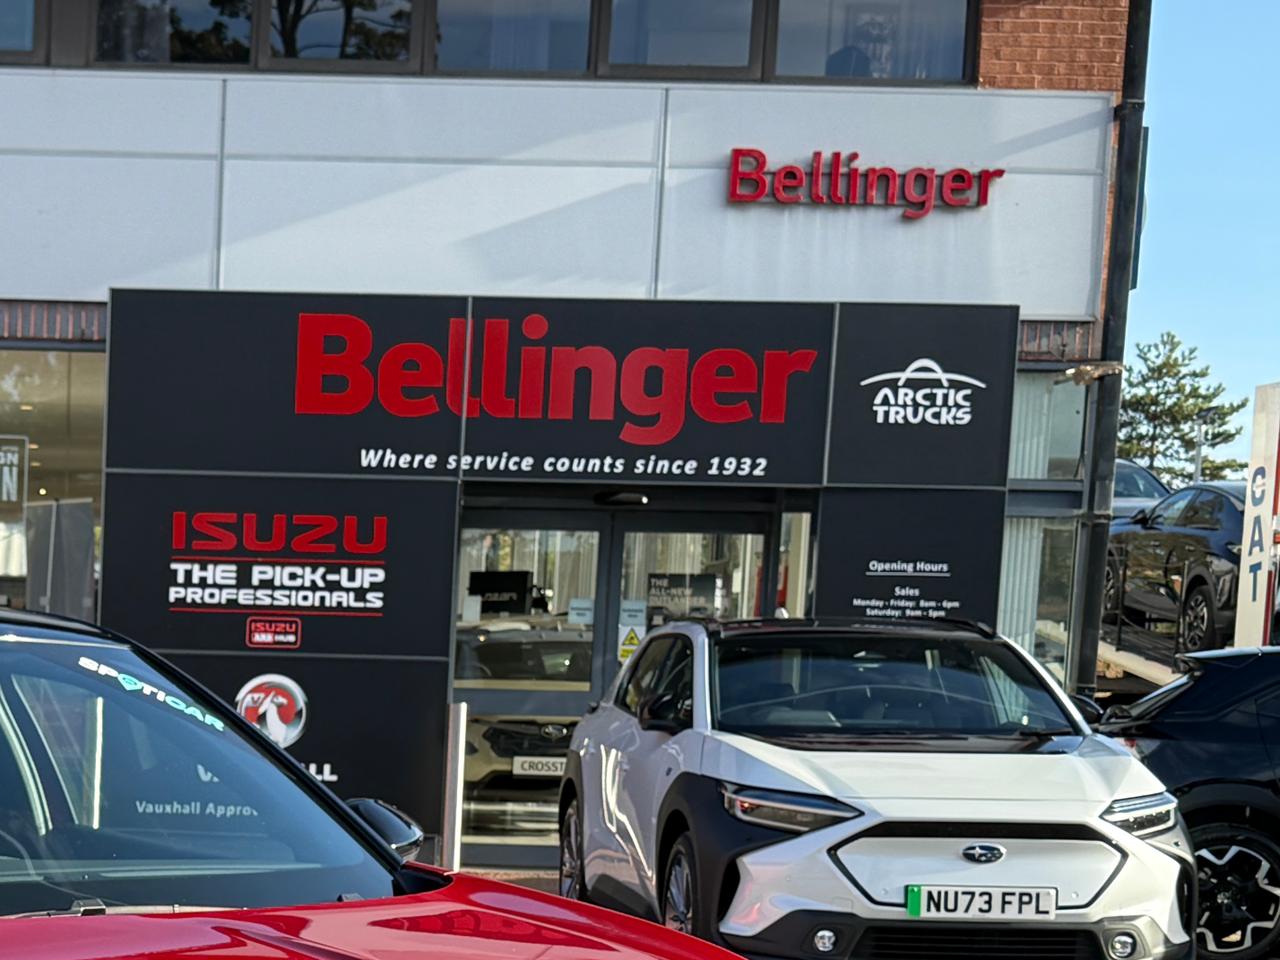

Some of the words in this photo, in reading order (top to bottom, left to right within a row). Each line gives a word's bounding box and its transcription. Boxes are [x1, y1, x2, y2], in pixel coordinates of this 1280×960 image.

[728, 148, 1006, 219] Bellinger
[295, 312, 818, 446] Bellinger
[873, 387, 972, 407] ARCTIC
[872, 405, 972, 425] TRUCKS
[360, 448, 437, 470] Where
[447, 451, 534, 472] service
[543, 454, 625, 475] counts
[634, 455, 698, 476] since
[707, 456, 768, 477] 1932
[172, 511, 388, 554] ISUZU
[170, 562, 238, 585] THE
[251, 564, 386, 589] PICK-UP
[868, 560, 915, 573] Opening
[916, 561, 949, 573] Hours
[168, 586, 384, 608] PROFESSIONALS
[894, 586, 920, 597] Sales
[852, 598, 884, 608] Monday
[251, 622, 296, 632] ISUZU
[135, 801, 200, 815] Vauxhall
[926, 890, 993, 914] NU73
[1001, 891, 1050, 915] FPL
